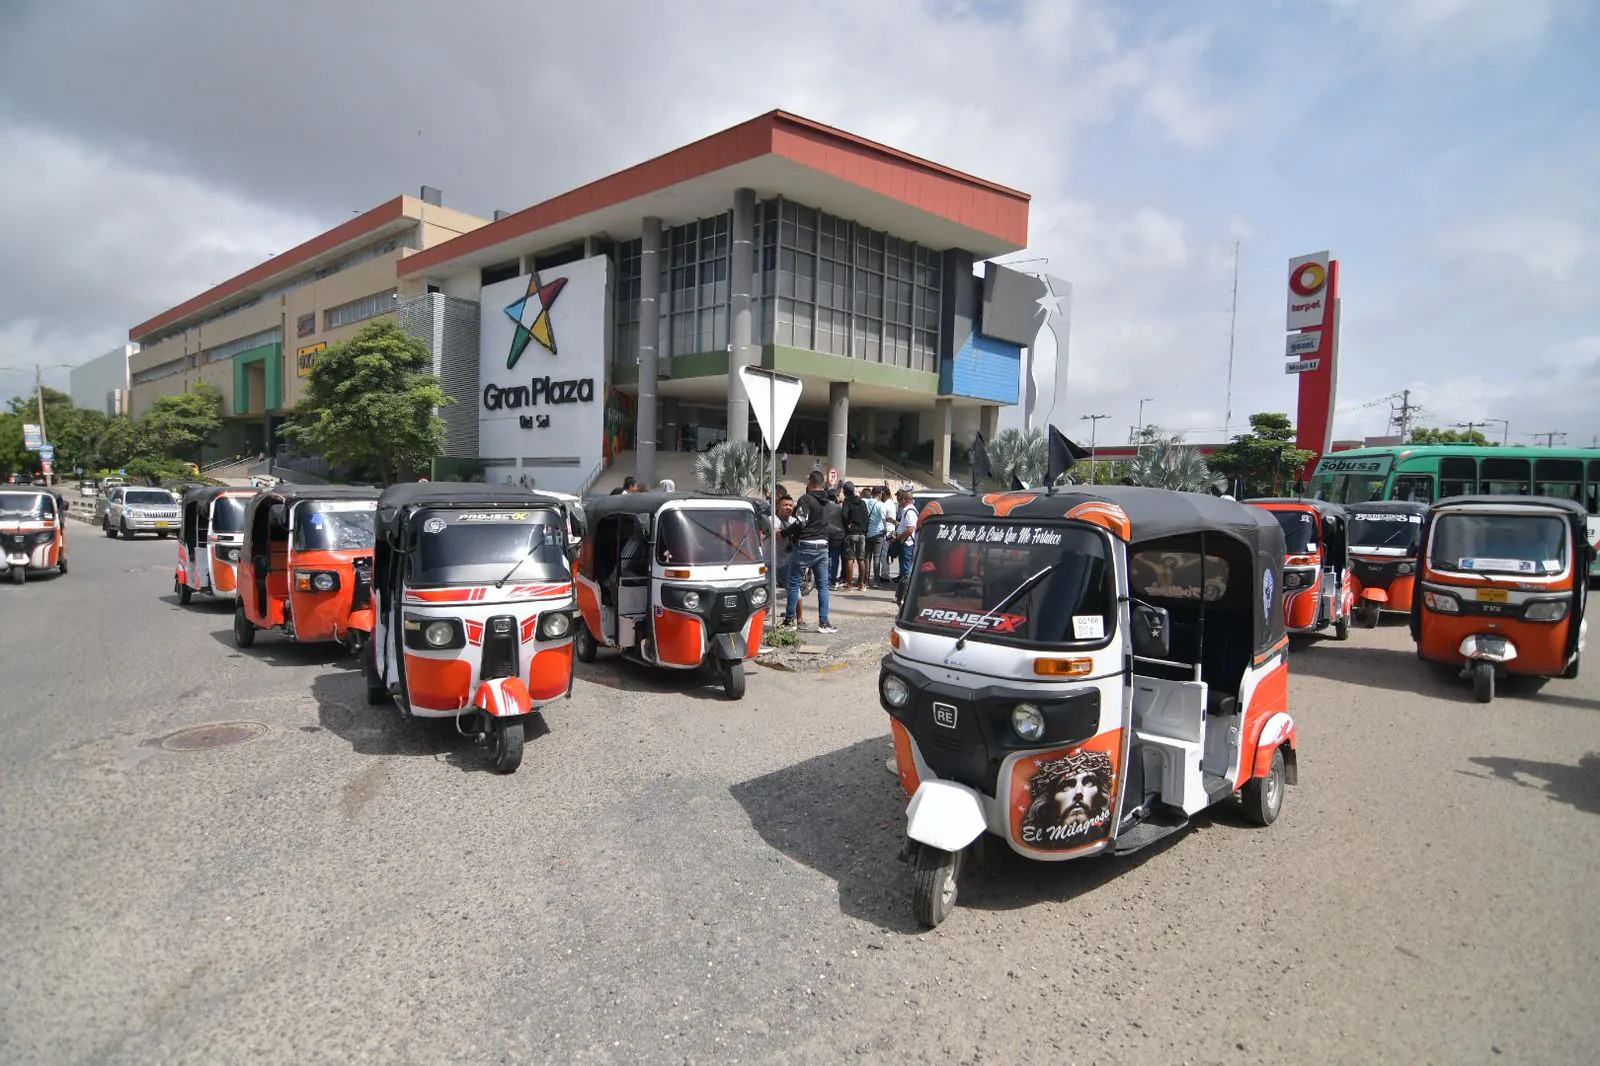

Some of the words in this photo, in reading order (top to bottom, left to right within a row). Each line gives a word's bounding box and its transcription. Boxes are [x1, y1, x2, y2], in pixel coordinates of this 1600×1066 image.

[1291, 299, 1321, 312] terpel
[484, 383, 530, 411] Gran
[531, 376, 594, 406] Plaza
[535, 414, 550, 428] Sol
[1003, 526, 1018, 545] Que
[1031, 527, 1062, 545] Fortalece
[937, 710, 953, 724] RE
[1022, 825, 1043, 842] El
[1045, 808, 1111, 841] Milagroso
